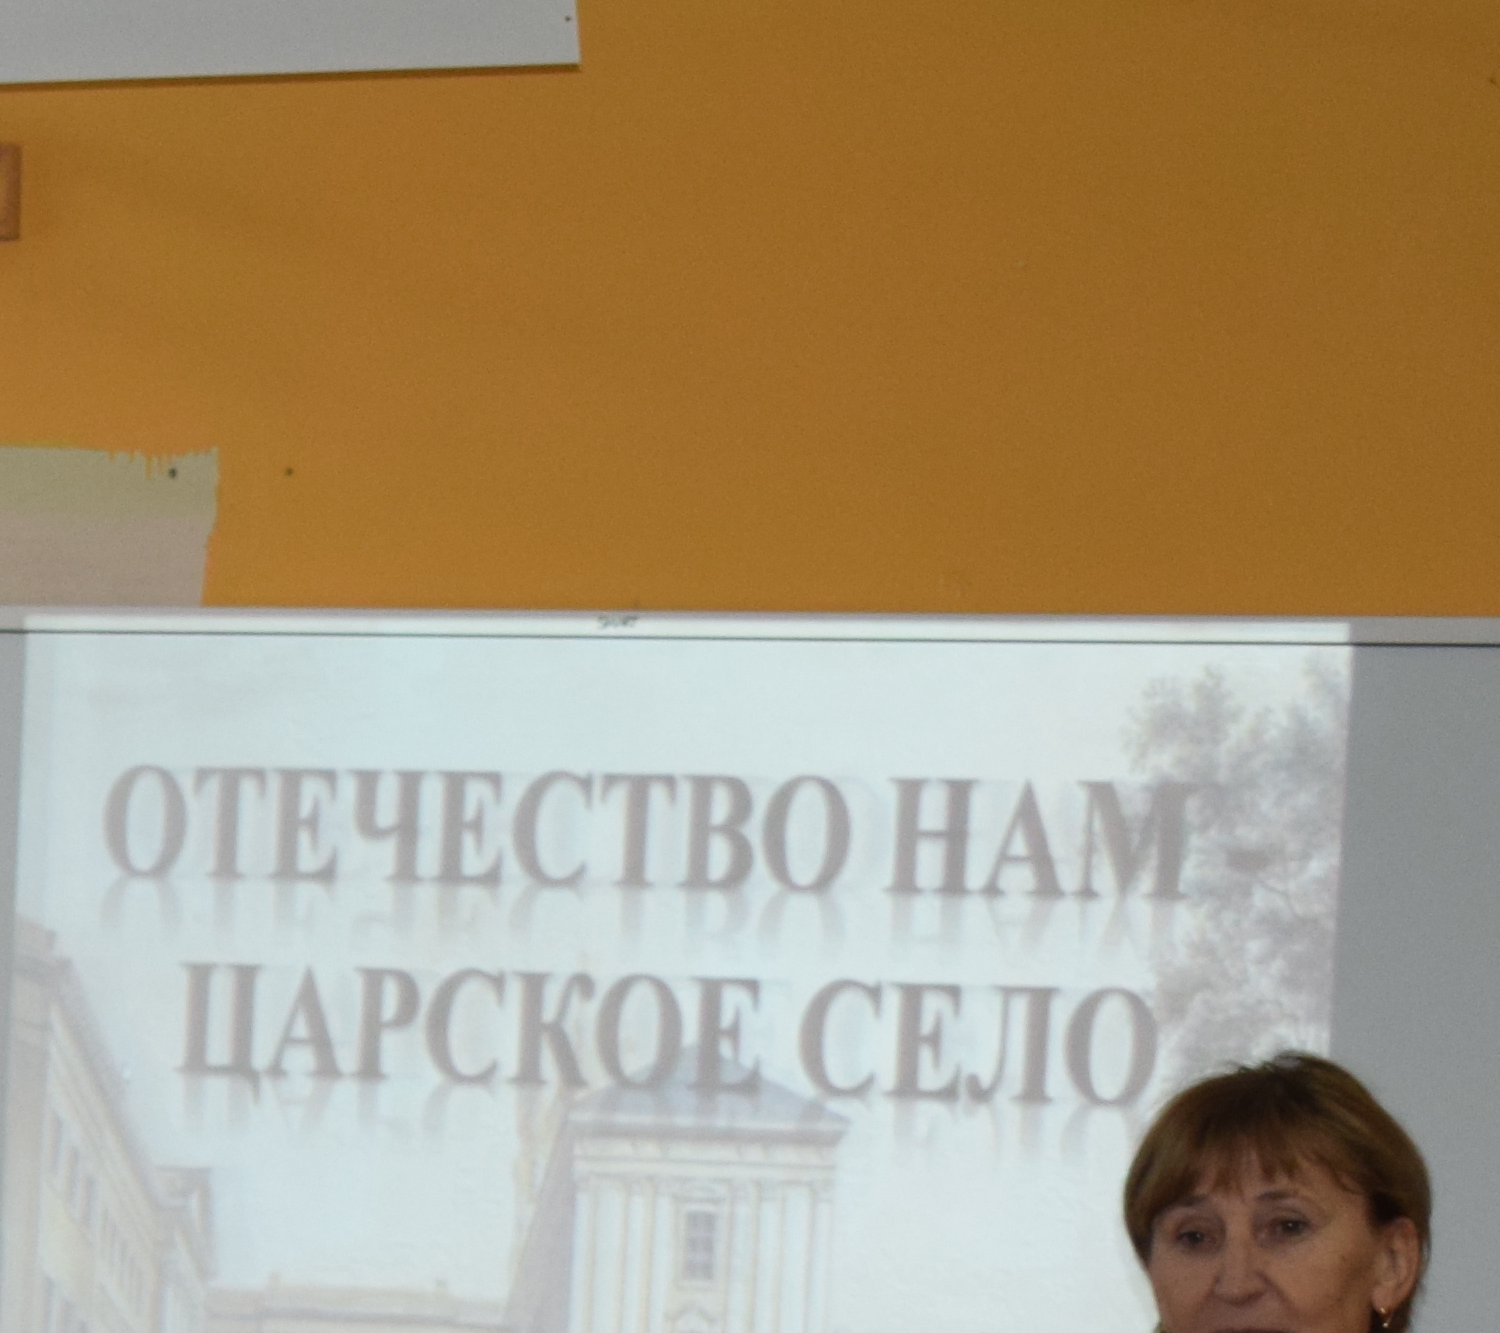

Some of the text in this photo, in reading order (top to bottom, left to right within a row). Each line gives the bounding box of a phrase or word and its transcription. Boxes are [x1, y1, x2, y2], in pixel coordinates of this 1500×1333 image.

[102, 764, 1192, 900] ОТЕЧЕСТВО НАМ
[179, 960, 1158, 1104] ЦАРСКОЕ СЕЛО
